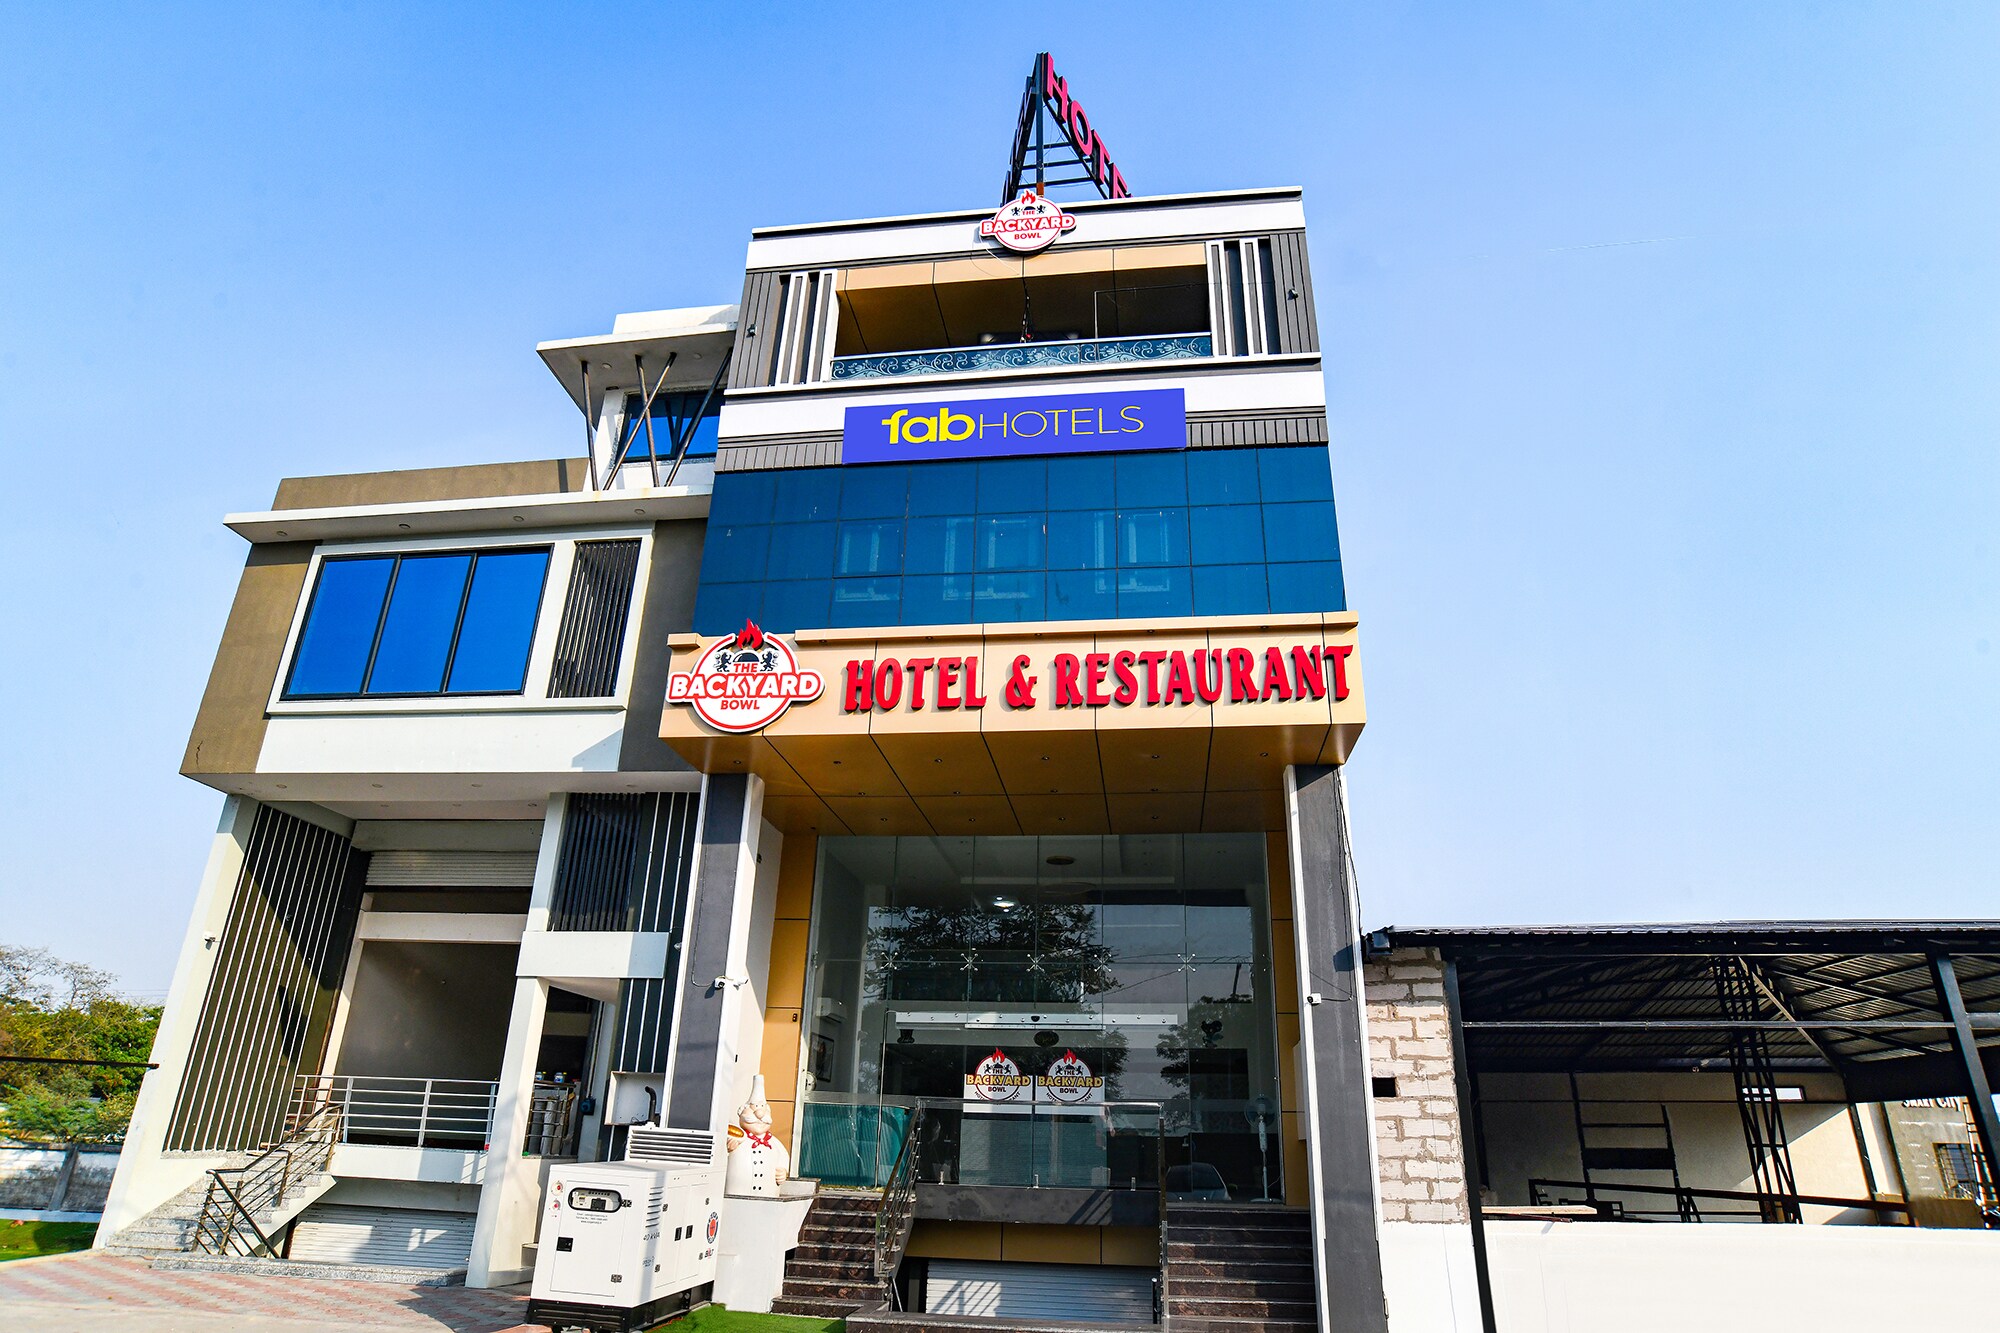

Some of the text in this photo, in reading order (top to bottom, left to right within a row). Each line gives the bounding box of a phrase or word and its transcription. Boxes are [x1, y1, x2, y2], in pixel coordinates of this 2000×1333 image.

[1047, 52, 1133, 199] HOTE
[981, 214, 1076, 235] BACKYARD
[1014, 231, 1042, 240] BOWL
[733, 662, 758, 673] THE
[844, 645, 1354, 711] HOTEL & RESTAURANT
[669, 671, 822, 700] BACKYARD
[720, 699, 760, 711] BOWL
[966, 1074, 1032, 1087] BACKYARD
[1037, 1075, 1103, 1088] BACKYARD
